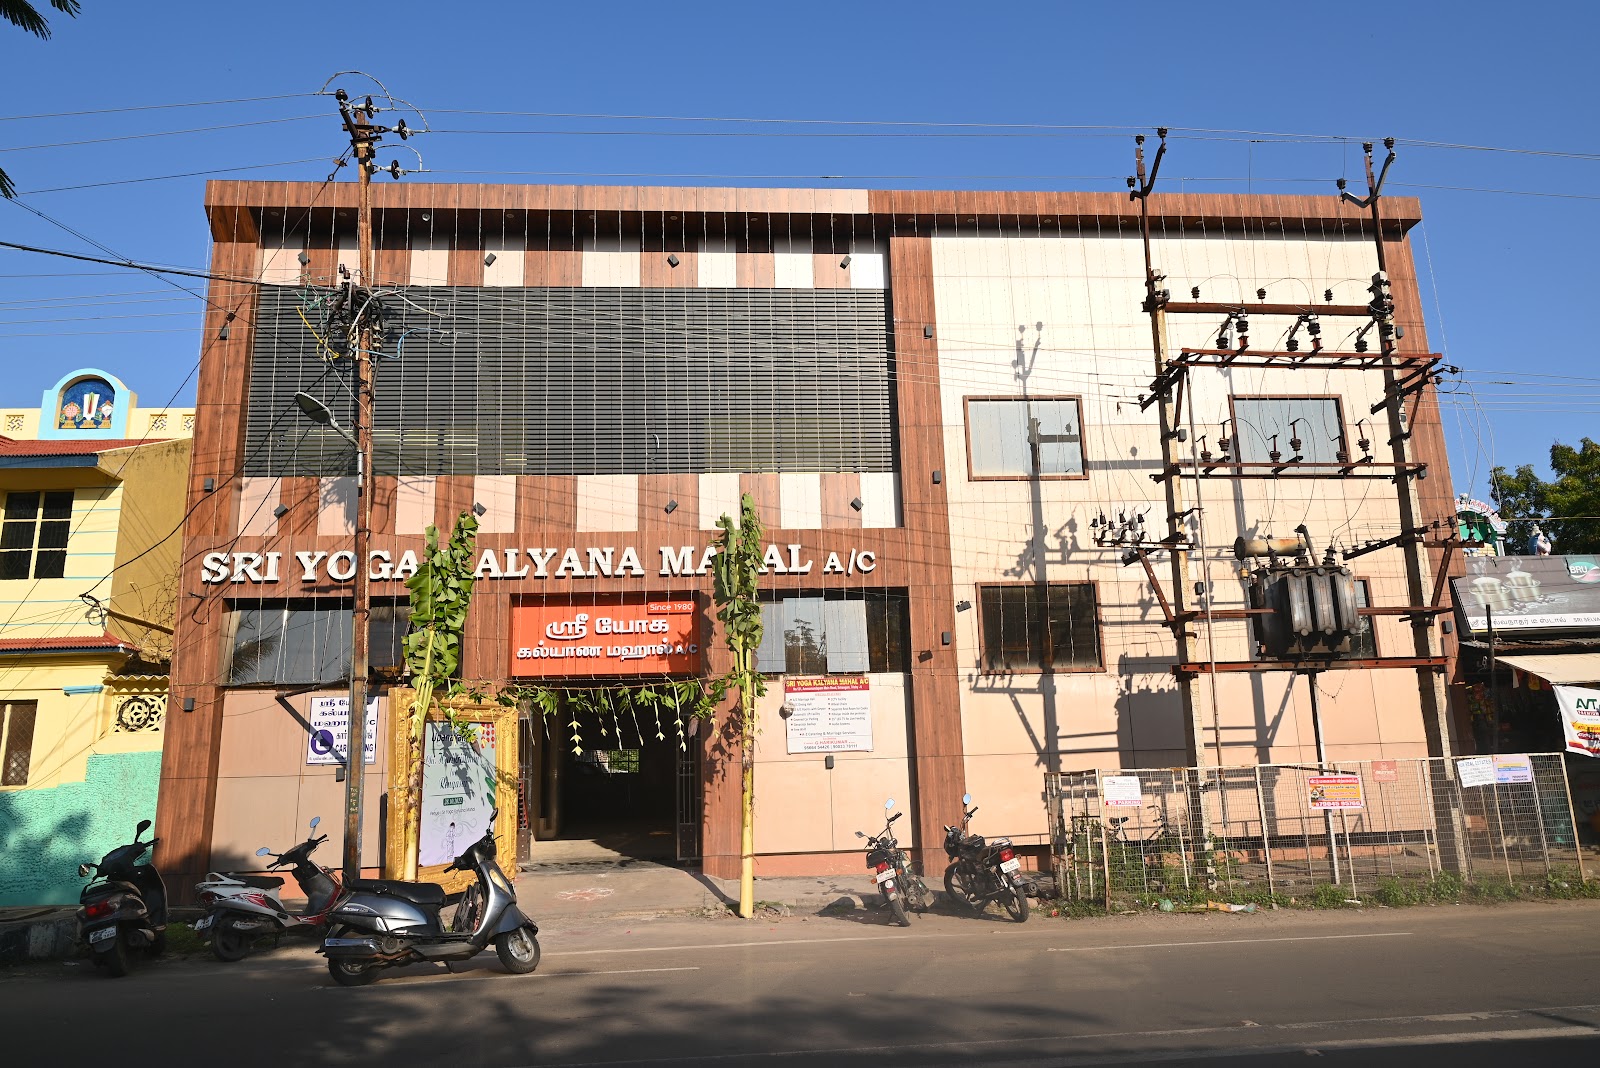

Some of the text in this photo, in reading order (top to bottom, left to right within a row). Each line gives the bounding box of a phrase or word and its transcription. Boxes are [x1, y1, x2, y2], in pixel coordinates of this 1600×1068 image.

[201, 546, 878, 584] SRI YOGA ALYANA MAAL A/C
[1569, 565, 1588, 574] BRU
[650, 603, 693, 611] Since 1980
[595, 617, 669, 634] யோக
[516, 640, 603, 659] கல்யாண
[606, 637, 673, 662] மஹால்
